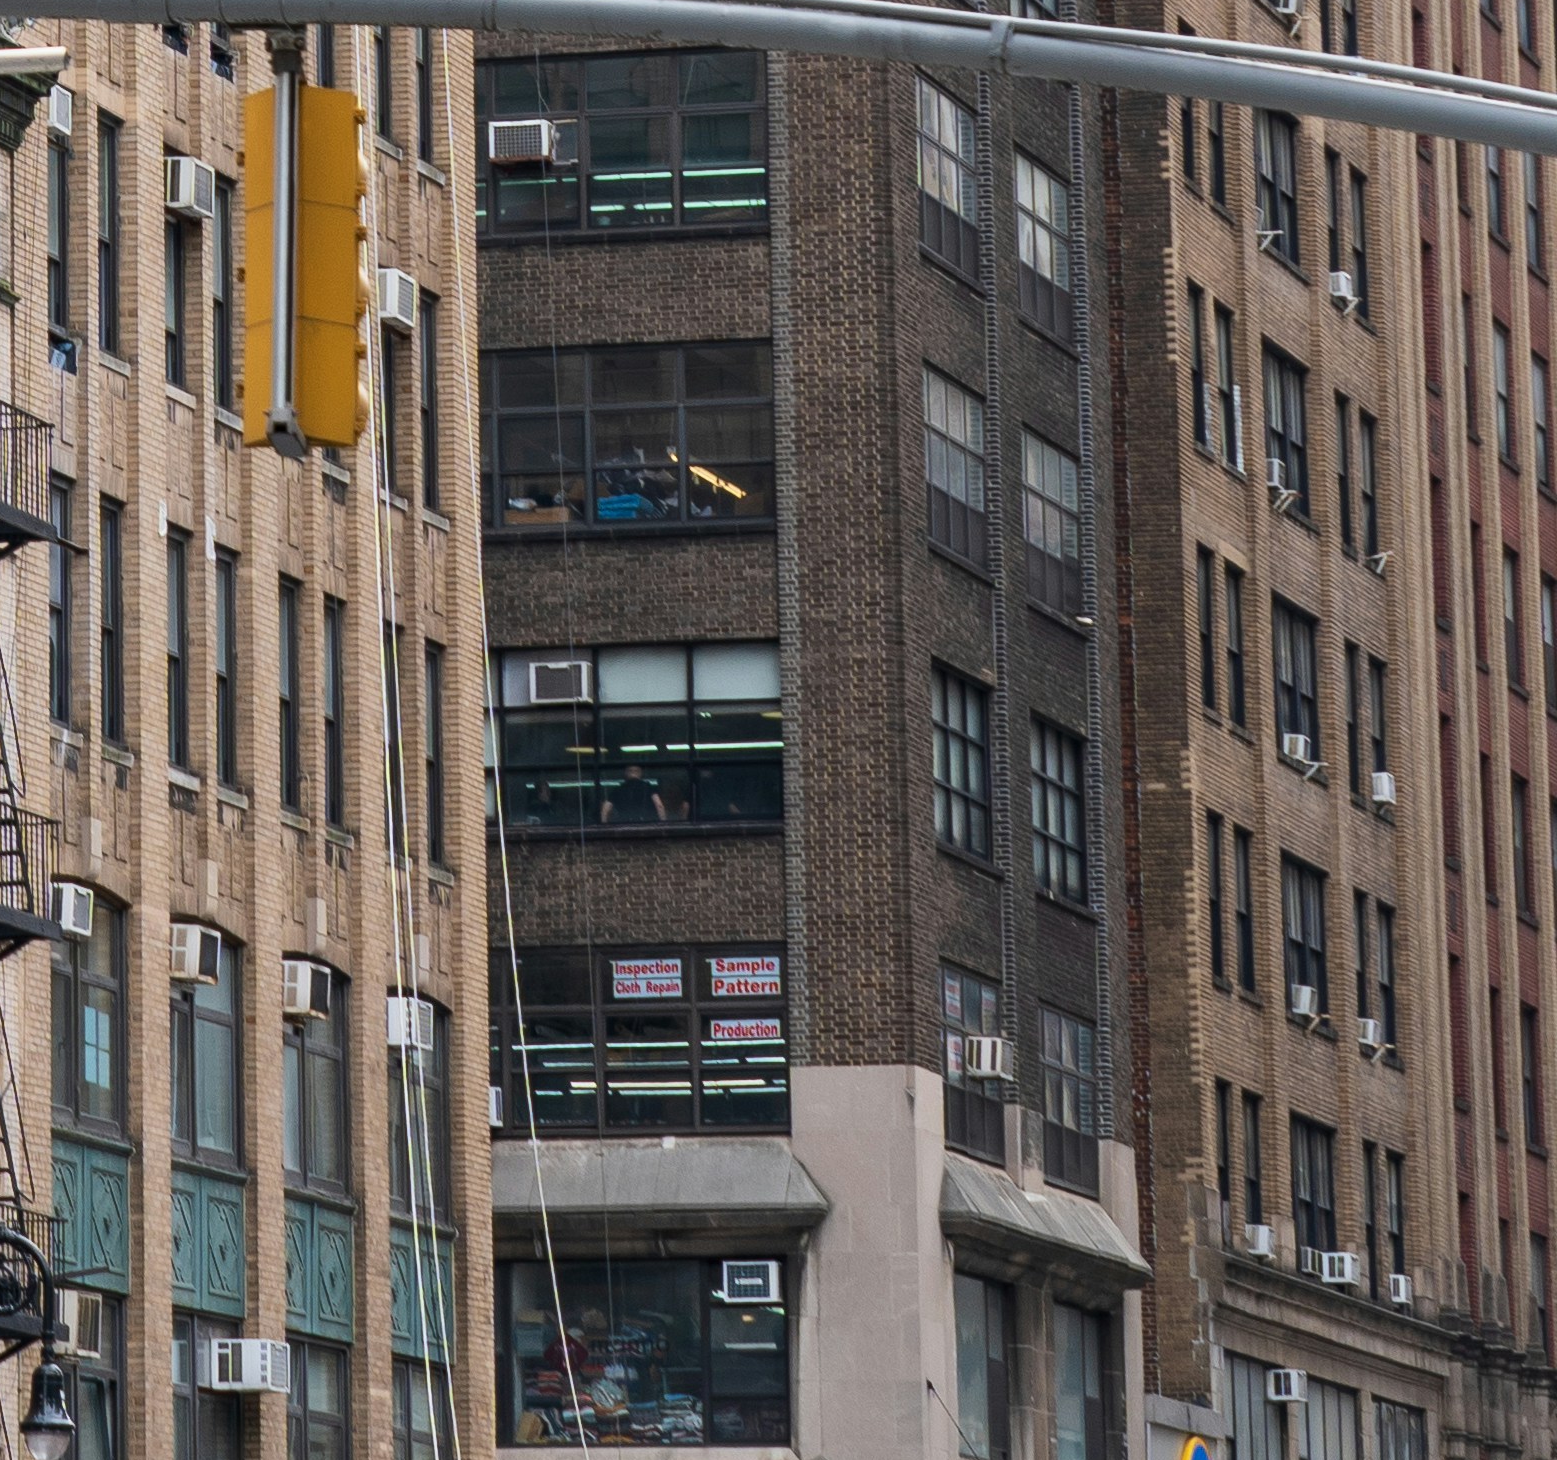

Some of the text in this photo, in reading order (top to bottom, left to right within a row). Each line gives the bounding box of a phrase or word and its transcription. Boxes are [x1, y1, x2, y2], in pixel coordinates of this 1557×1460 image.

[614, 960, 679, 977] Inspection
[714, 958, 776, 976] Sample
[614, 979, 680, 996] Cloth Repair
[713, 979, 779, 995] Pattern
[713, 1021, 778, 1037] Production
